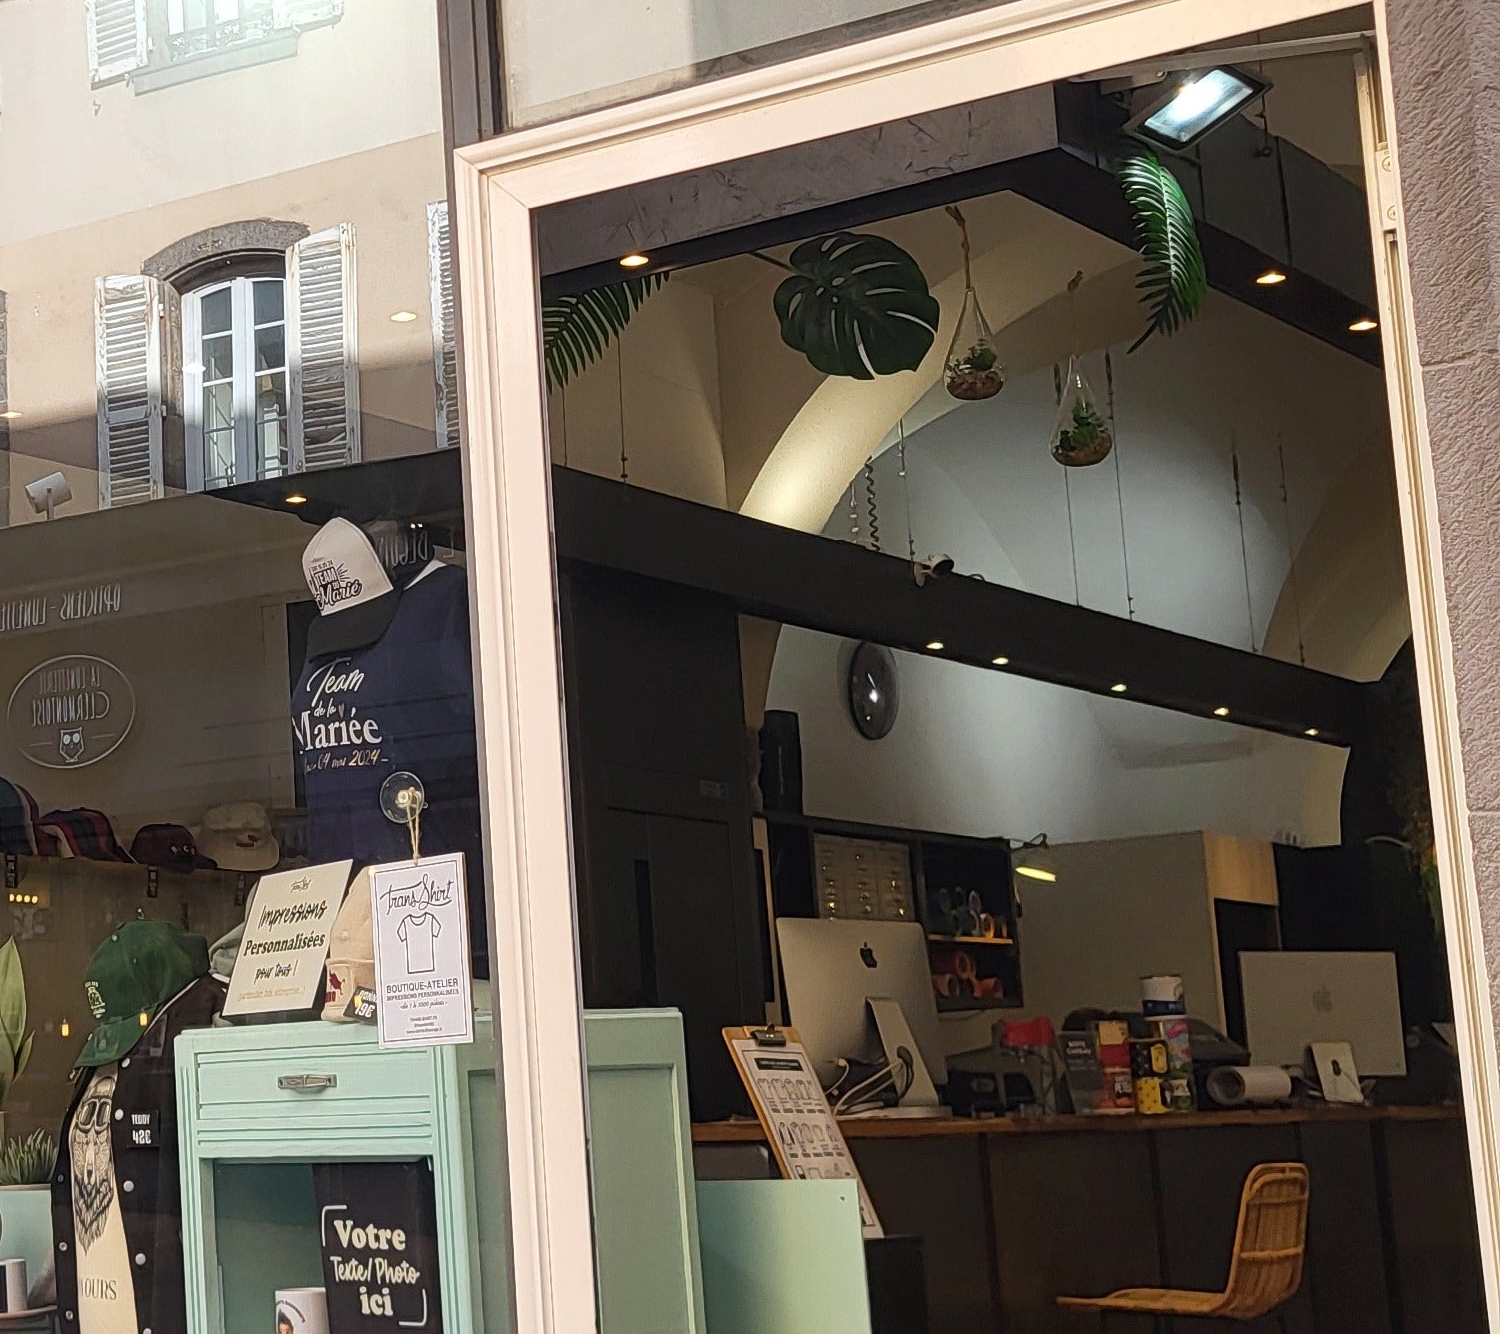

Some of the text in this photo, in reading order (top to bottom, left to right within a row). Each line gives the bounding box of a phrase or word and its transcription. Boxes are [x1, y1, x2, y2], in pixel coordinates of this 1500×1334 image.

[315, 567, 337, 585] TEAM
[316, 579, 362, 611] Marié
[306, 657, 365, 707] Team
[292, 707, 382, 751] Mariée
[348, 749, 380, 766] 2024
[257, 900, 328, 932] Impressions
[243, 930, 326, 957] Personnalisées
[386, 977, 459, 994] BOUTIQUE-ATELIER
[333, 1219, 406, 1250] Votre
[359, 1286, 393, 1315] ici
